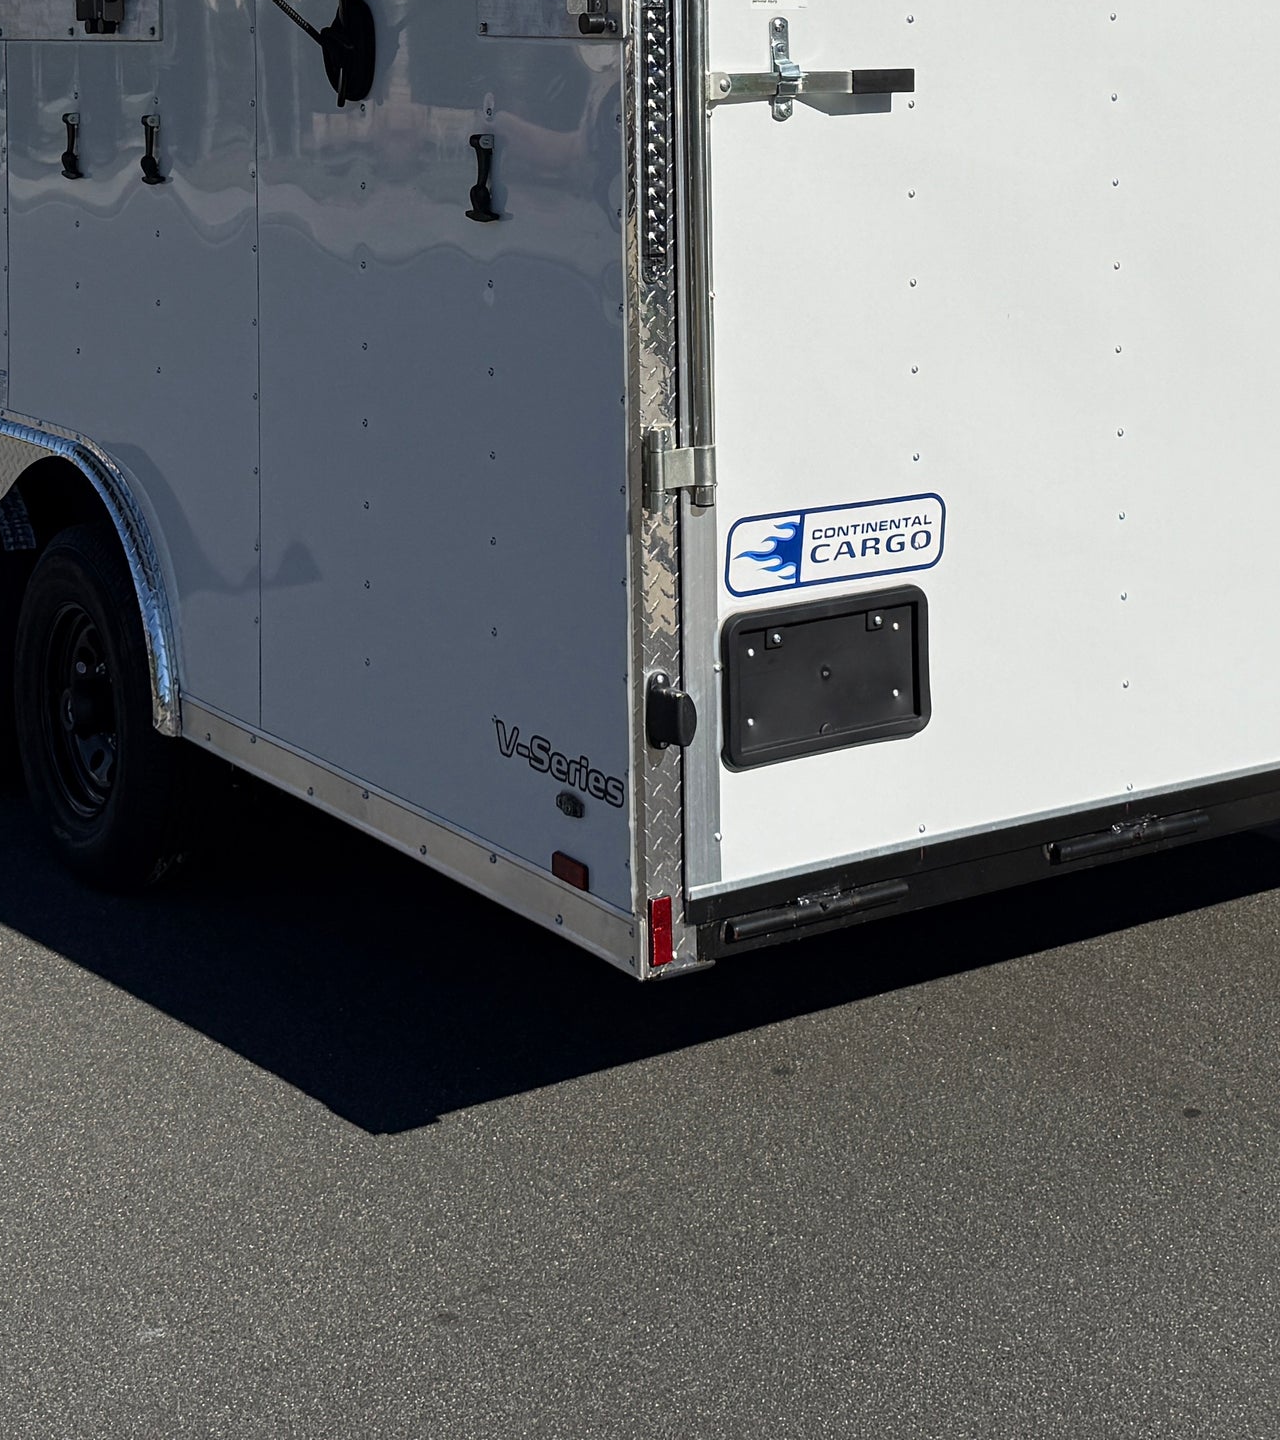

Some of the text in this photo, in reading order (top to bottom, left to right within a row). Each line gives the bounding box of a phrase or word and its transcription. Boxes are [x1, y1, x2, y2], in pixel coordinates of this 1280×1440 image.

[812, 514, 932, 540] CONTINENTAL
[810, 530, 932, 564] CARGO
[495, 719, 625, 808] V-Series
